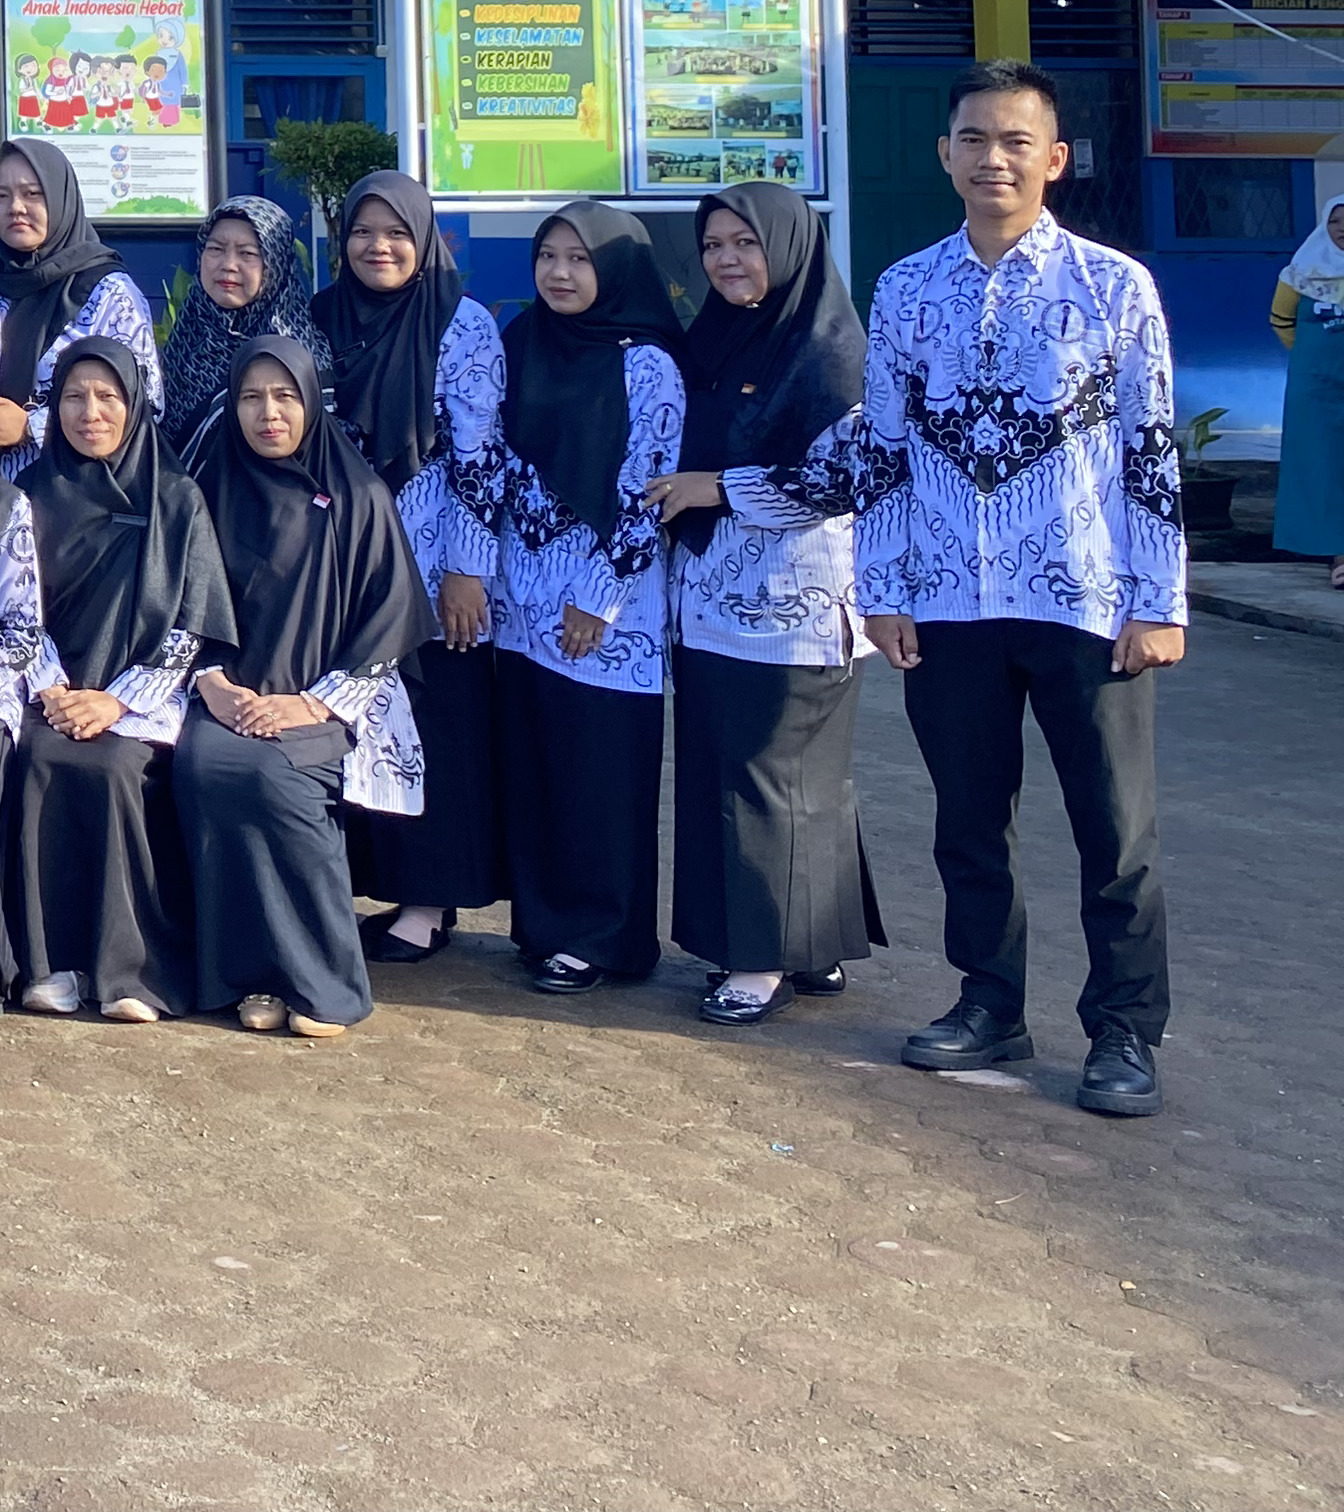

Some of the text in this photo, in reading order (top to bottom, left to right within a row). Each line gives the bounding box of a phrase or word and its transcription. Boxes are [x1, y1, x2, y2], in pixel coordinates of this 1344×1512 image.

[23, 0, 184, 15] Anak Indonesia Hebat
[1252, 0, 1306, 9] RINCIAN
[474, 28, 584, 46] KESELAMATAN
[476, 51, 552, 69] KERAPIAN
[476, 74, 570, 93] KEBERSIHAN
[477, 96, 576, 115] KREATIVITAS
